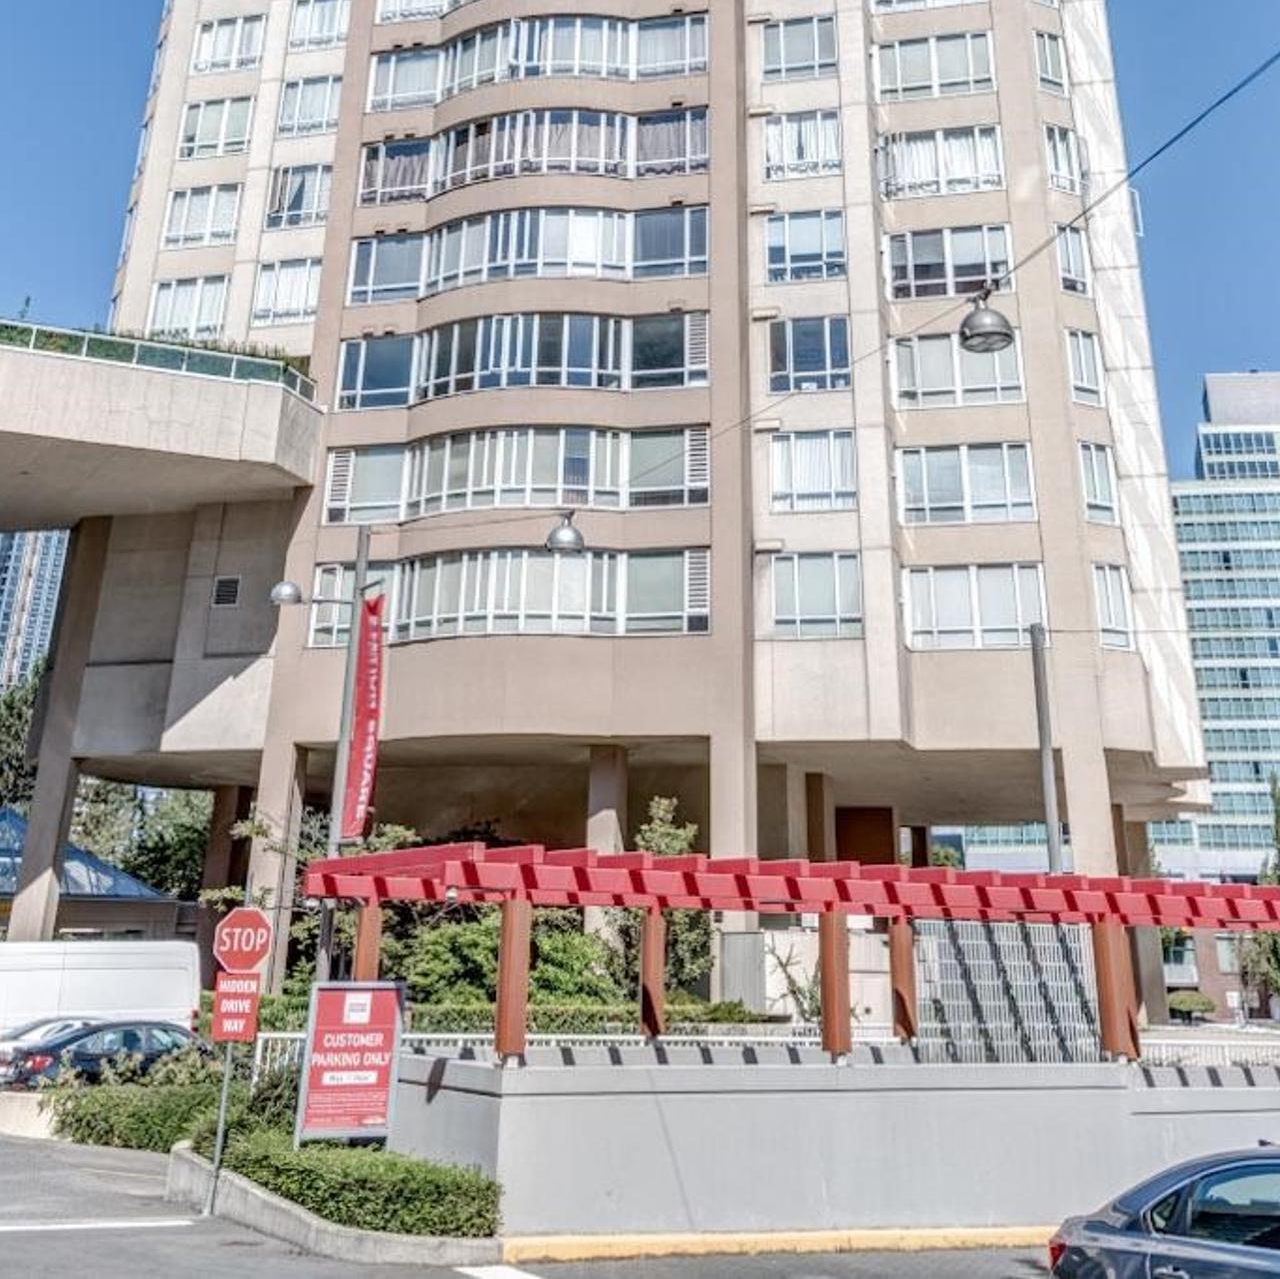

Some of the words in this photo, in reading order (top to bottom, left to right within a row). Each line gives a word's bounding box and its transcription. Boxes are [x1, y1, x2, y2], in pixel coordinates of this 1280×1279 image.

[355, 719, 376, 820] SQUARE
[220, 927, 268, 952] STOP
[219, 979, 257, 994] HIDDEN
[221, 999, 252, 1013] DRIVE
[222, 1018, 246, 1033] WAY
[323, 1033, 384, 1047] CUSTOMER
[312, 1052, 360, 1066] PARKING
[363, 1052, 391, 1065] ONLY
